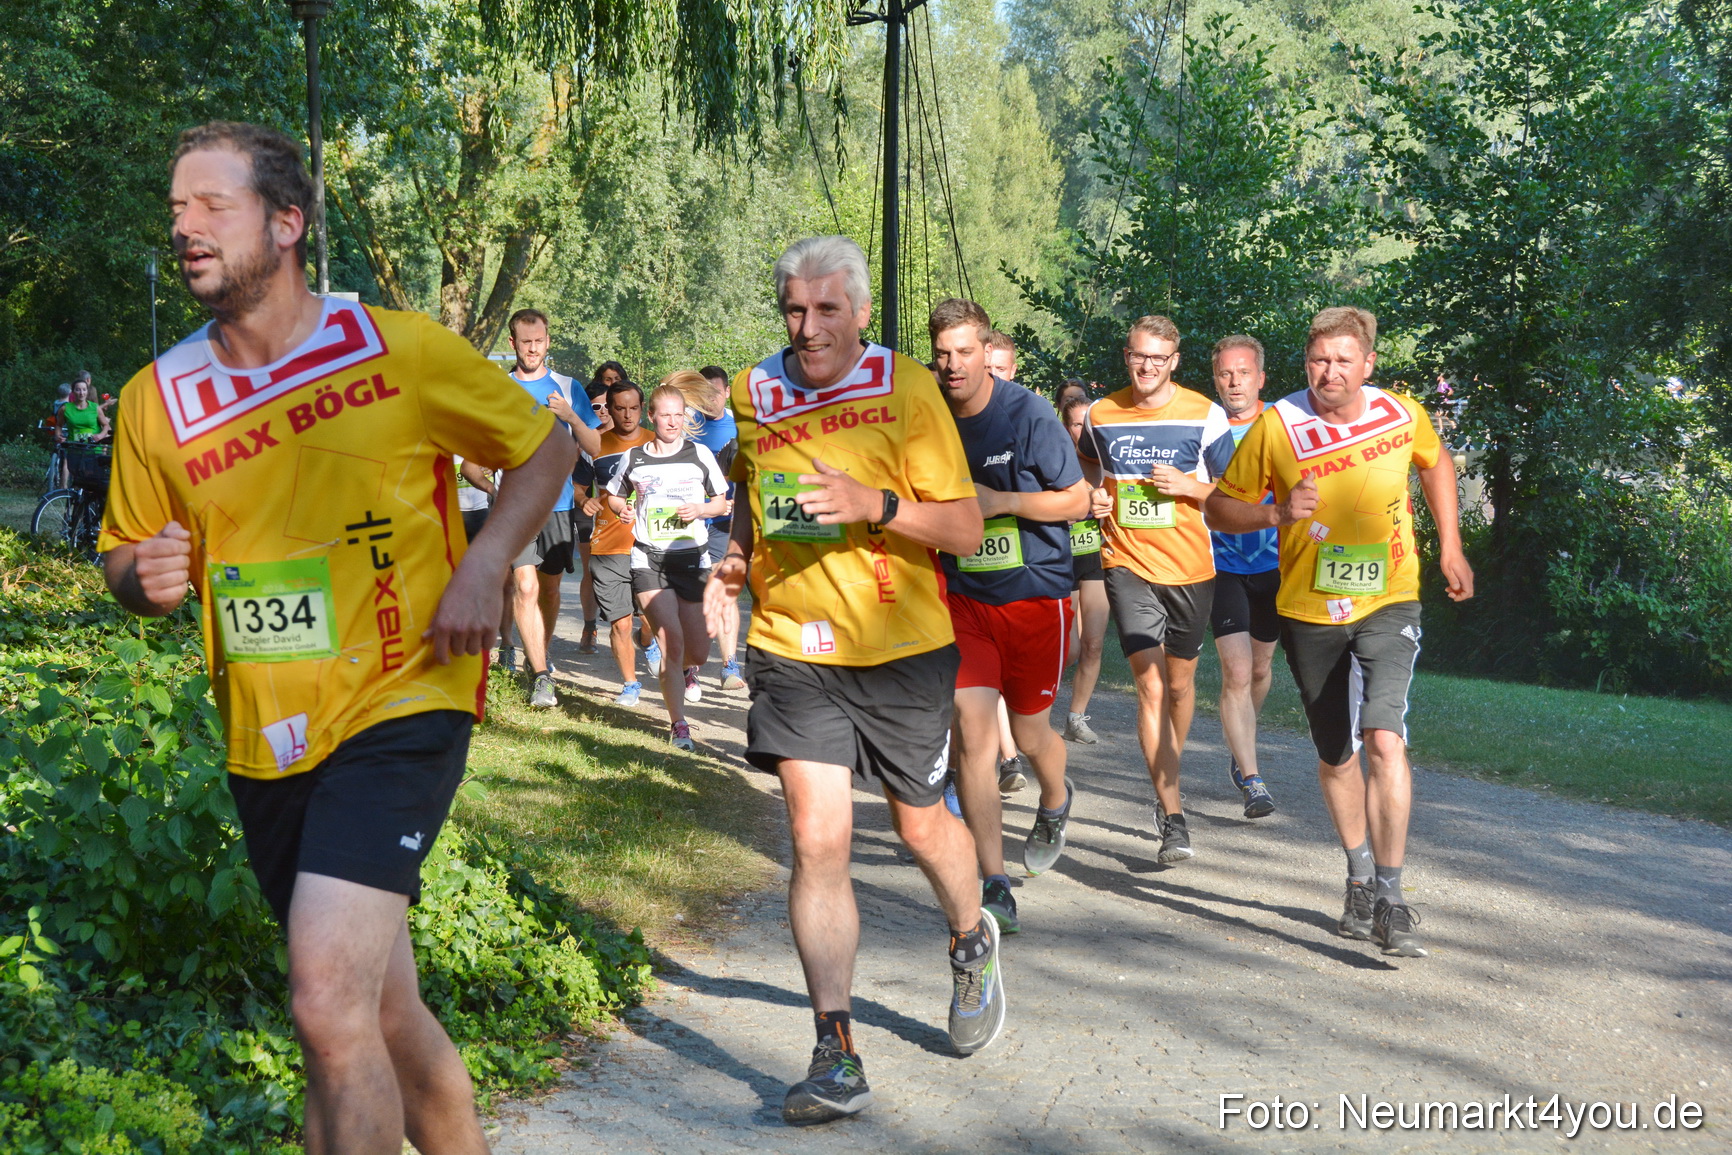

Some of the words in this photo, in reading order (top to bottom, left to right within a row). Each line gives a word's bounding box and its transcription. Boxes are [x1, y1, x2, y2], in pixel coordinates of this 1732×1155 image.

[184, 420, 280, 487] MAX
[286, 373, 401, 435] BÖGL
[756, 422, 813, 455] MAX
[821, 406, 896, 435] BÖGL
[1119, 446, 1179, 458] Fischer
[1300, 454, 1357, 480] MAX
[1361, 431, 1413, 462] BÖGL
[1129, 500, 1158, 516] 561
[1327, 561, 1379, 581] 1219
[226, 595, 316, 633] 1334
[242, 635, 270, 646] Ziegler
[273, 634, 302, 643] David
